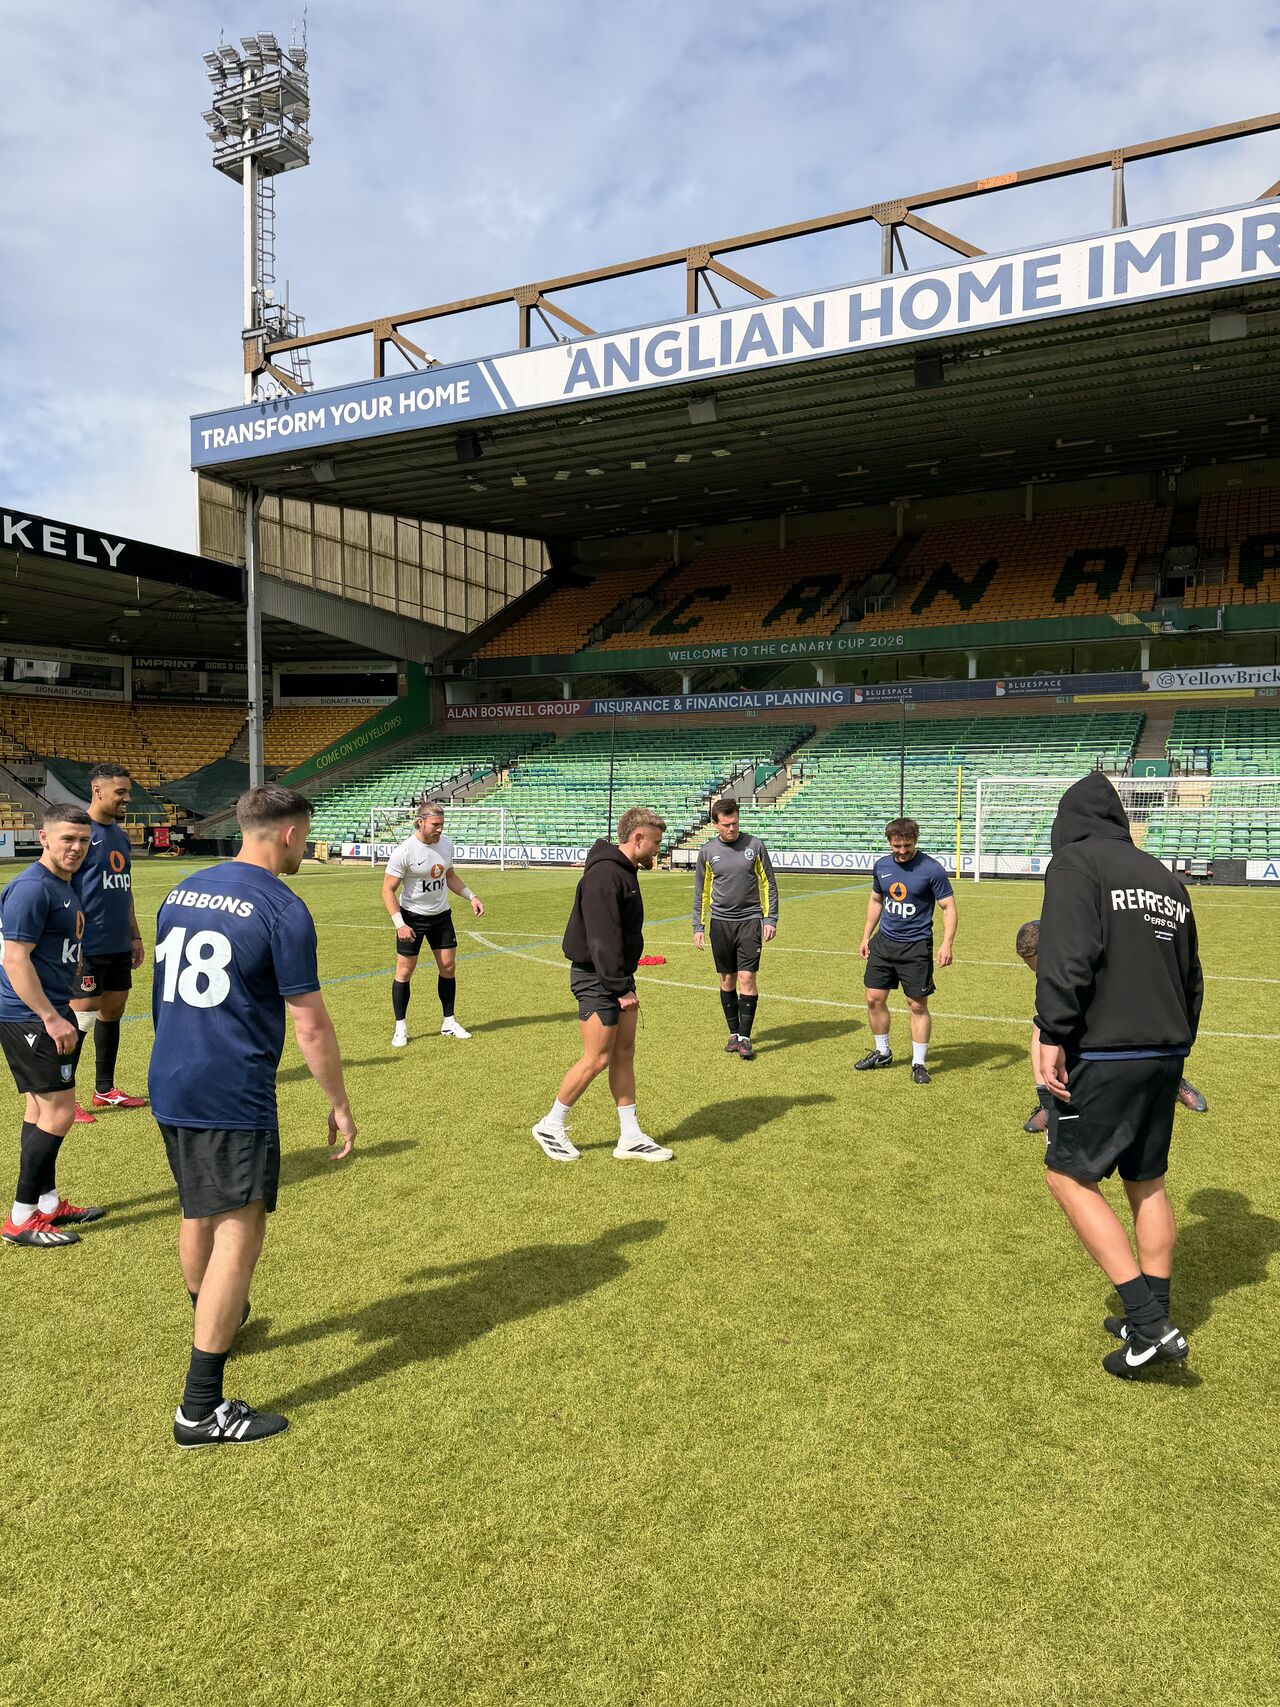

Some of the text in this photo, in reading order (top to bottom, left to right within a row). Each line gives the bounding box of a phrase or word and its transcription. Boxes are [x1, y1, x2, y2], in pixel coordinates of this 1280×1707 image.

[563, 300, 824, 393] ANGLIAN
[849, 253, 1062, 343] HOME
[200, 380, 471, 450] TRANSFORM YOUR HOME
[669, 635, 904, 661] WELCOME TO THE CANARY CUP 2026
[135, 658, 198, 668] IMPRINT
[204, 661, 226, 670] SIGNS
[33, 686, 69, 695] SIGNAGE
[71, 689, 94, 697] MADE
[865, 687, 913, 697] BLUESPACE
[1008, 680, 1062, 689] BLUESPACE
[447, 703, 580, 718] ALAN BOSWELL GROUP
[594, 690, 844, 714] INSURANCE & FINANCIAL PLANNING
[316, 714, 403, 769] COME ON YOU YELLOWS!
[1145, 766, 1156, 778] C
[469, 846, 537, 860] FINANCIAL
[540, 847, 590, 862] SERVIC
[771, 853, 814, 867] ALAN
[103, 871, 131, 893] knp
[166, 889, 254, 918] GIBBONS
[885, 897, 917, 919] knp
[155, 926, 232, 1009] 18
